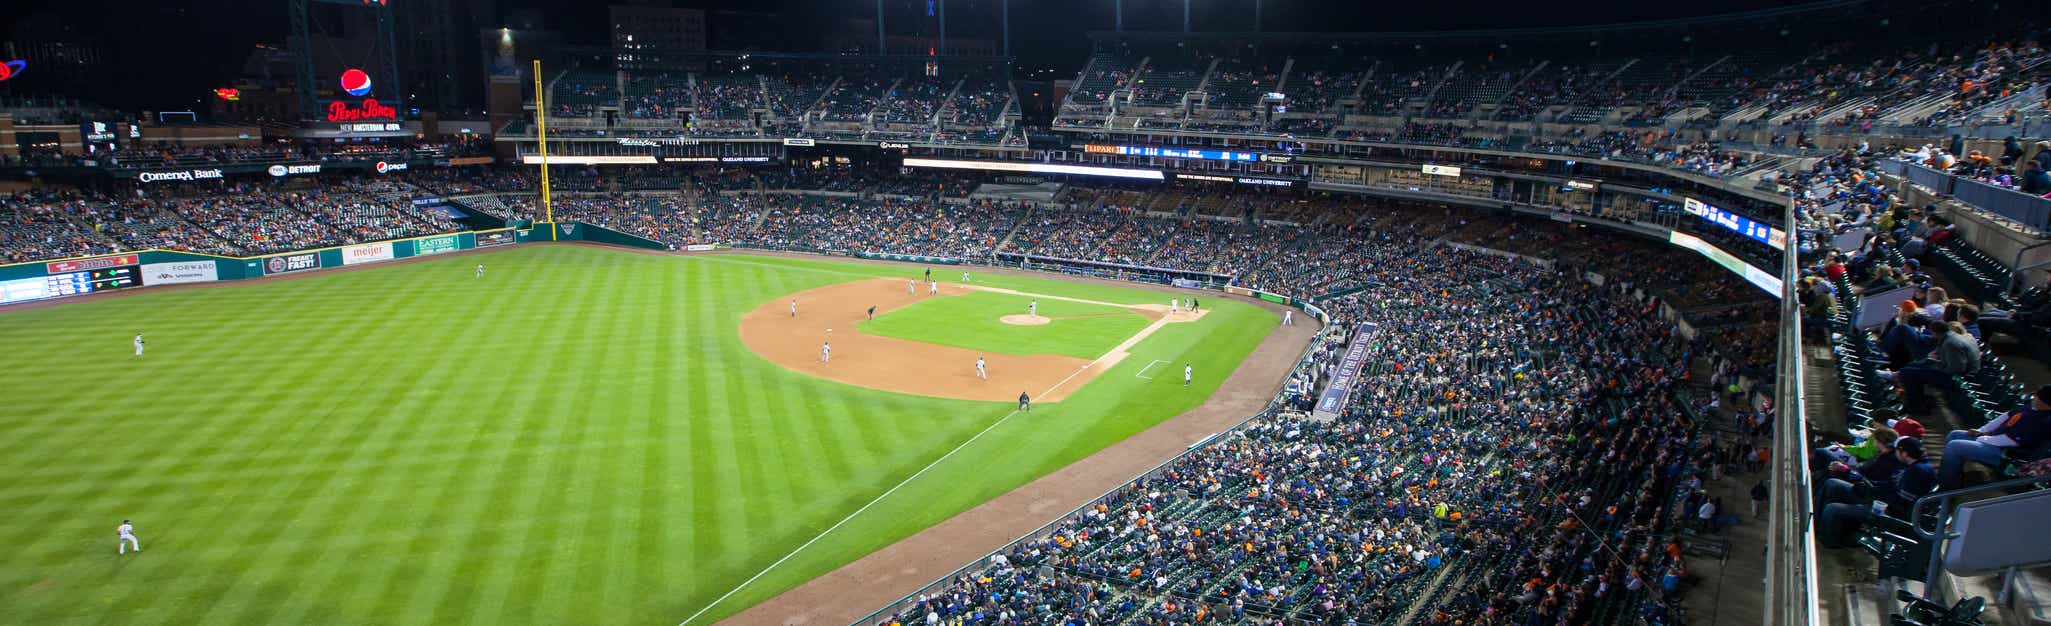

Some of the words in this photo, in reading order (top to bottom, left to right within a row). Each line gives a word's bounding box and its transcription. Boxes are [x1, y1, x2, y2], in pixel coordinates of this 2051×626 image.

[288, 165, 320, 173] DETROIT
[194, 169, 223, 179] Bank
[1263, 179, 1292, 187] UNIVERSITY
[419, 237, 453, 247] EASTERN
[353, 245, 383, 257] meijer
[288, 254, 314, 262] FREAKY
[288, 260, 314, 269] FAST!
